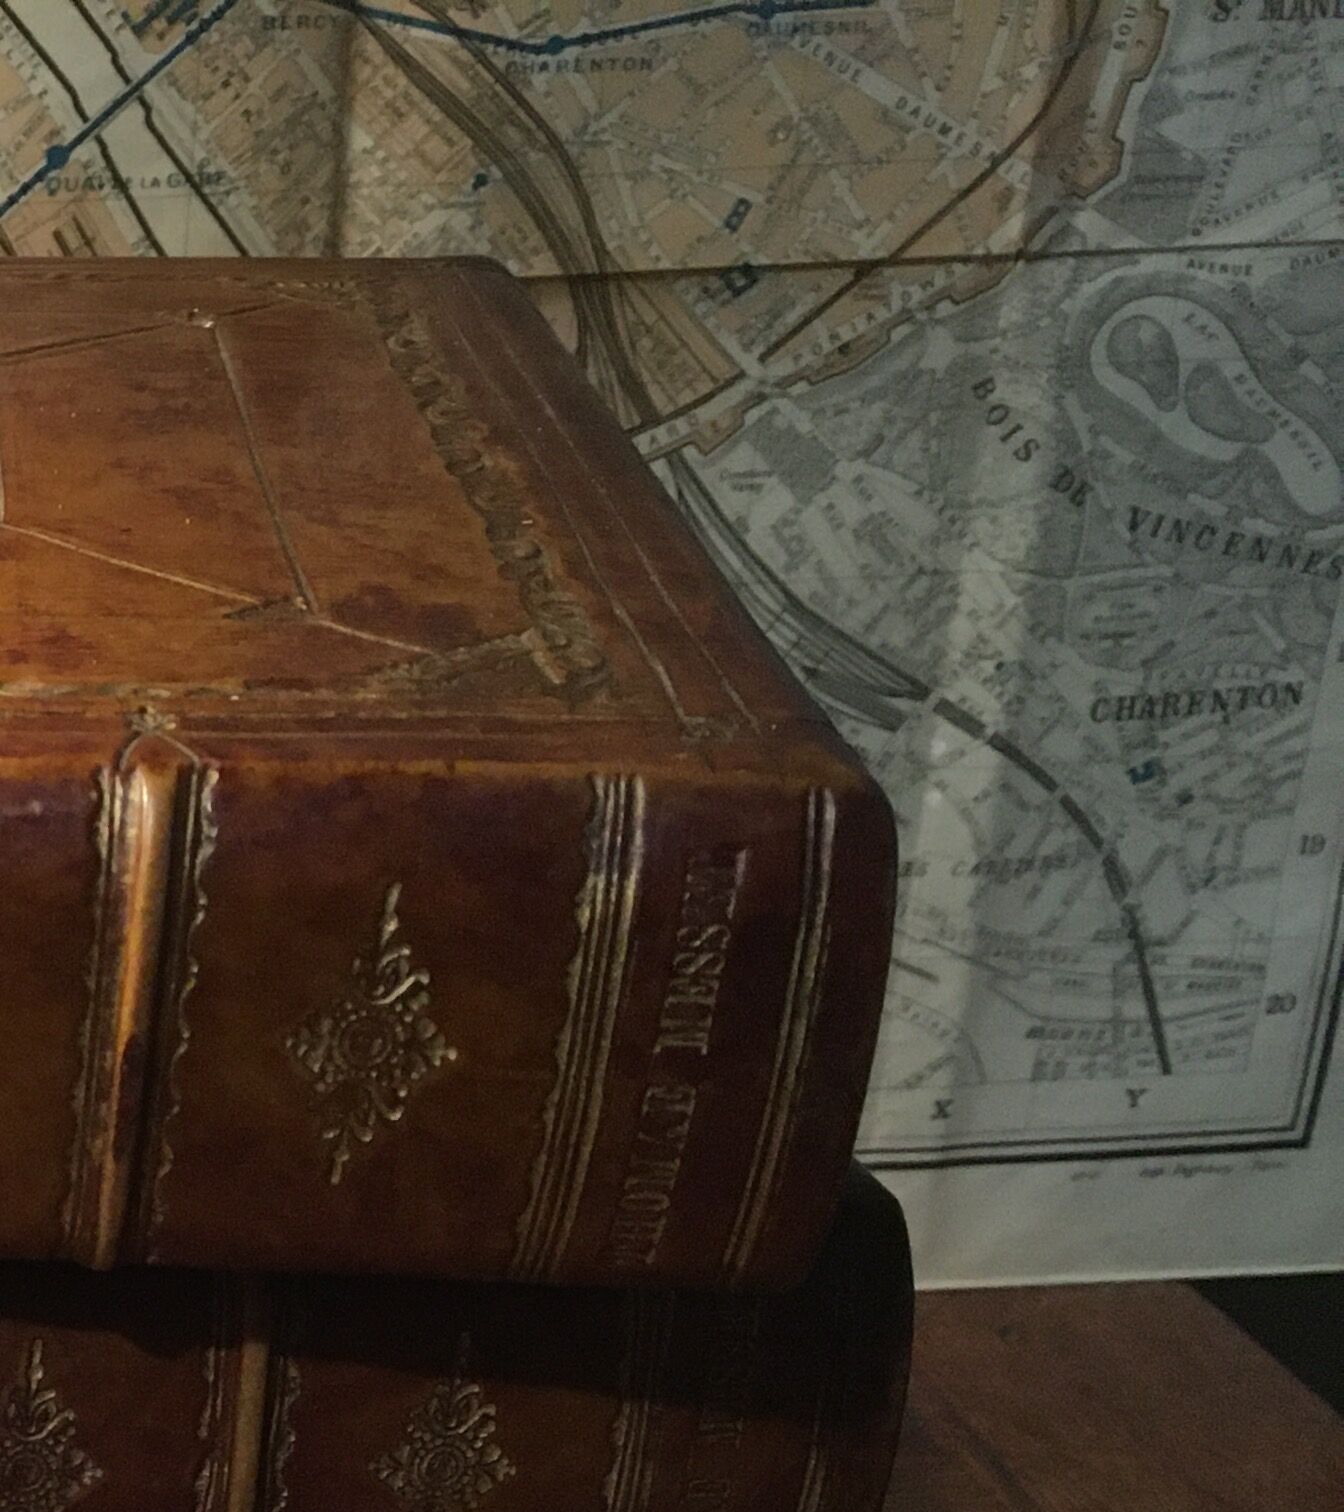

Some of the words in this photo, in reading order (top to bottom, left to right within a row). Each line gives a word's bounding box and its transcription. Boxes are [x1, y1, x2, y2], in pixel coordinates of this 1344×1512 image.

[970, 375, 1041, 463] BOIS
[1047, 462, 1096, 508] DE
[1128, 503, 1344, 582] VINCENNES
[1298, 833, 1328, 855] 19
